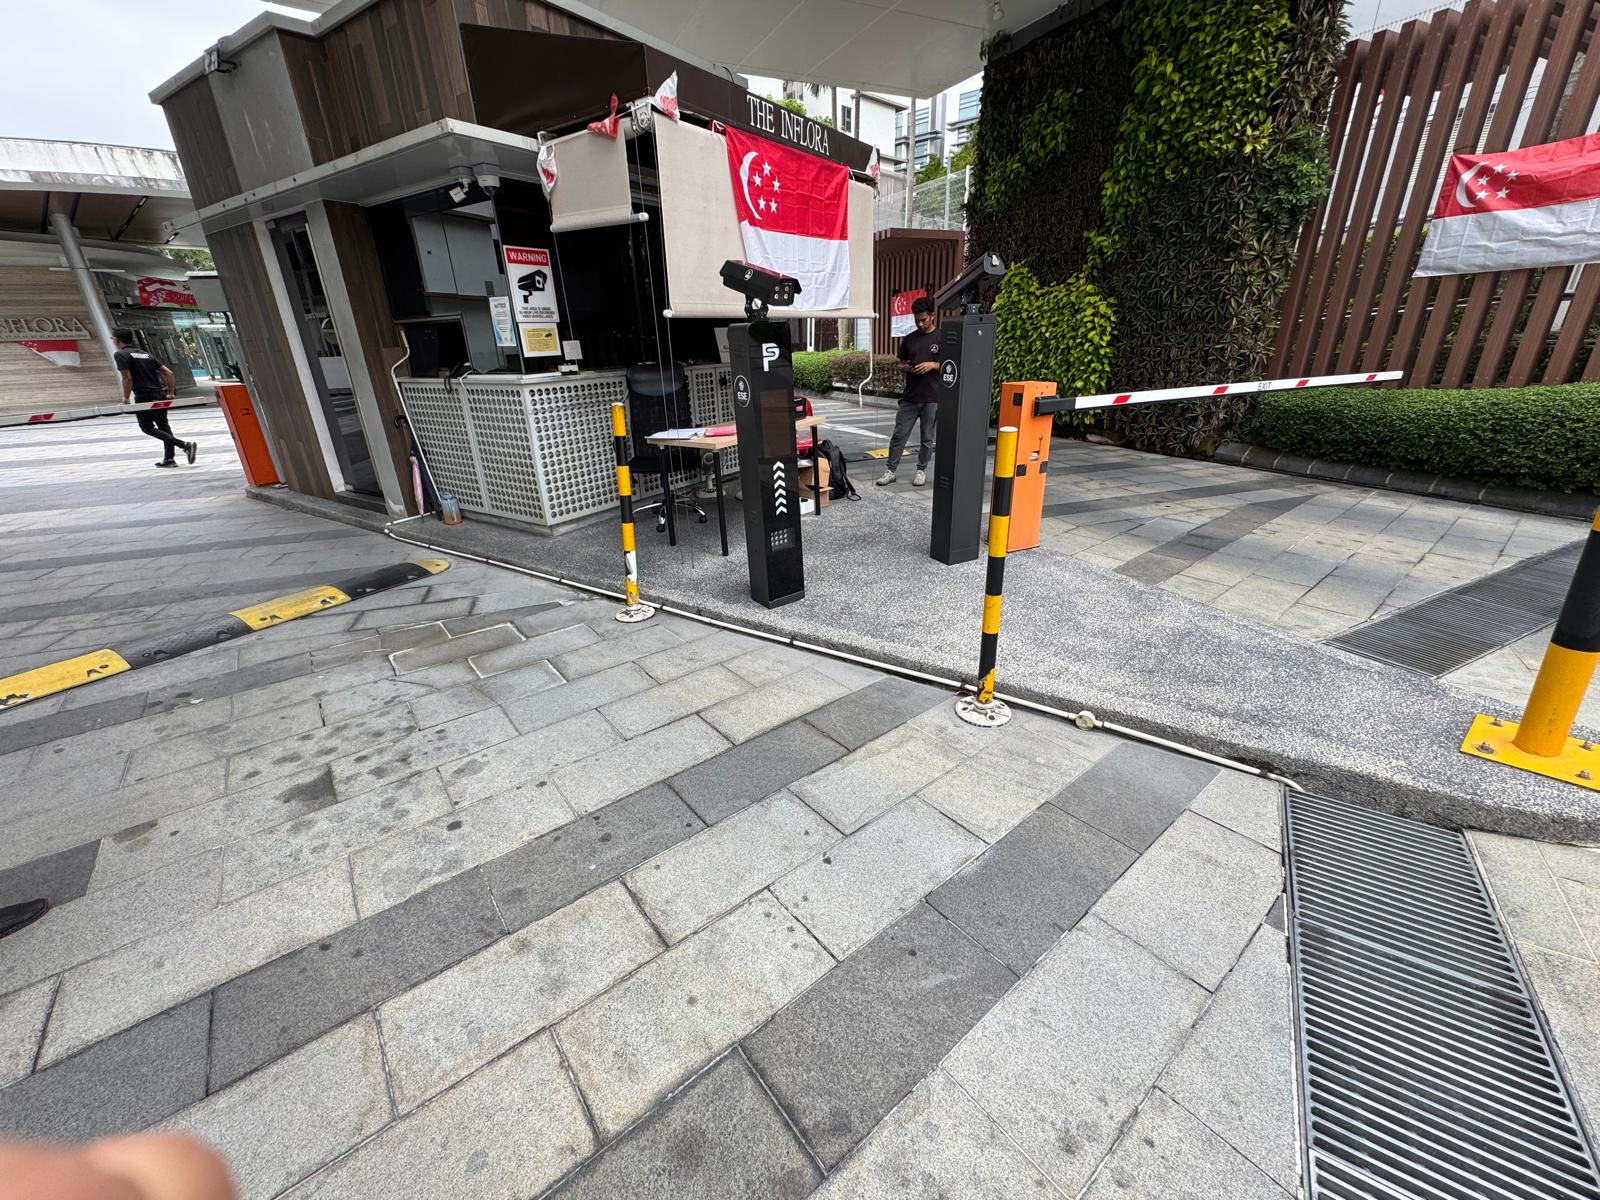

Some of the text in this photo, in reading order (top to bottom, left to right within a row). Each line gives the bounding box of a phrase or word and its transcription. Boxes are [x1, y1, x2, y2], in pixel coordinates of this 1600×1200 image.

[746, 94, 830, 156] THE INFLORA
[508, 250, 547, 262] WARNING
[943, 374, 954, 382] ESE
[1258, 382, 1272, 390] EXIT
[738, 392, 748, 400] ESE
